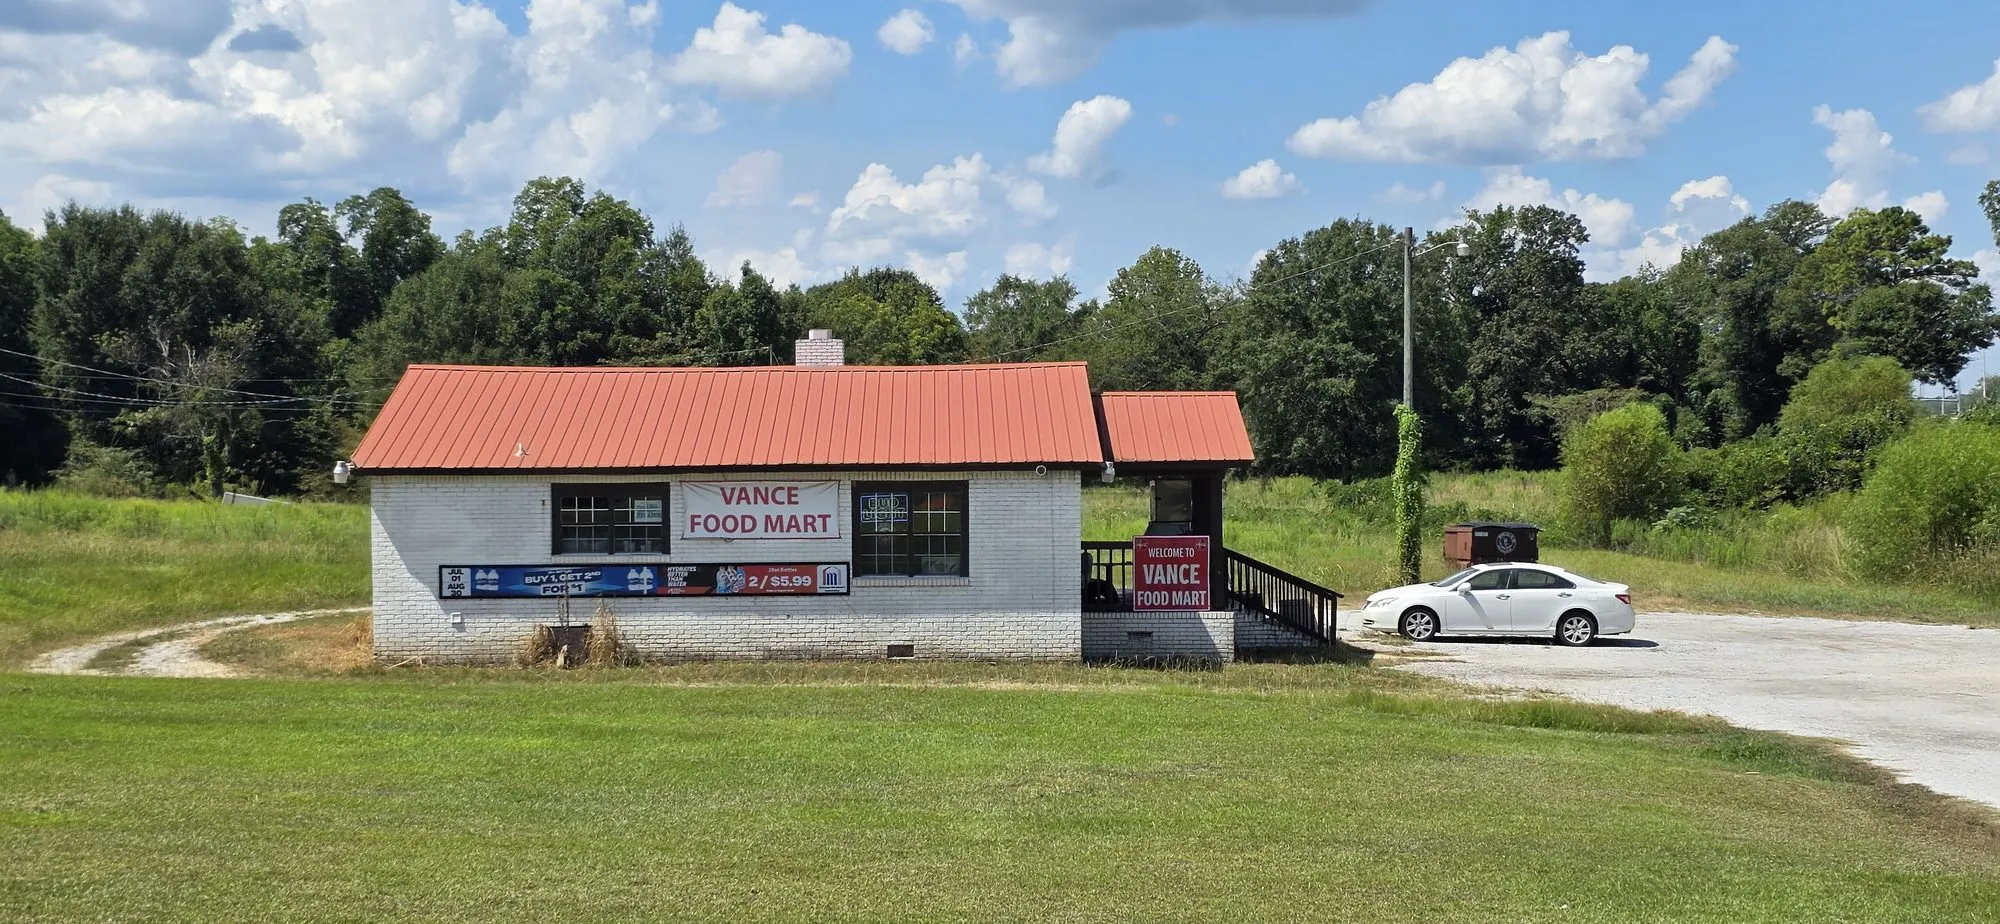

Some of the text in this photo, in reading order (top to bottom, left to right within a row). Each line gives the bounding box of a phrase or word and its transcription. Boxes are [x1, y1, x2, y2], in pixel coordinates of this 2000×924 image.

[720, 486, 799, 505] VANCE
[868, 498, 900, 509] BUD
[690, 514, 831, 533] FOOD MART
[1148, 547, 1195, 558] WELCOME TO
[525, 575, 549, 584] BUY
[550, 575, 558, 583] 1,
[560, 572, 583, 581] GET
[1142, 564, 1200, 585] VANCE
[542, 584, 569, 594] FOR
[1137, 591, 1206, 606] FOOD MART
